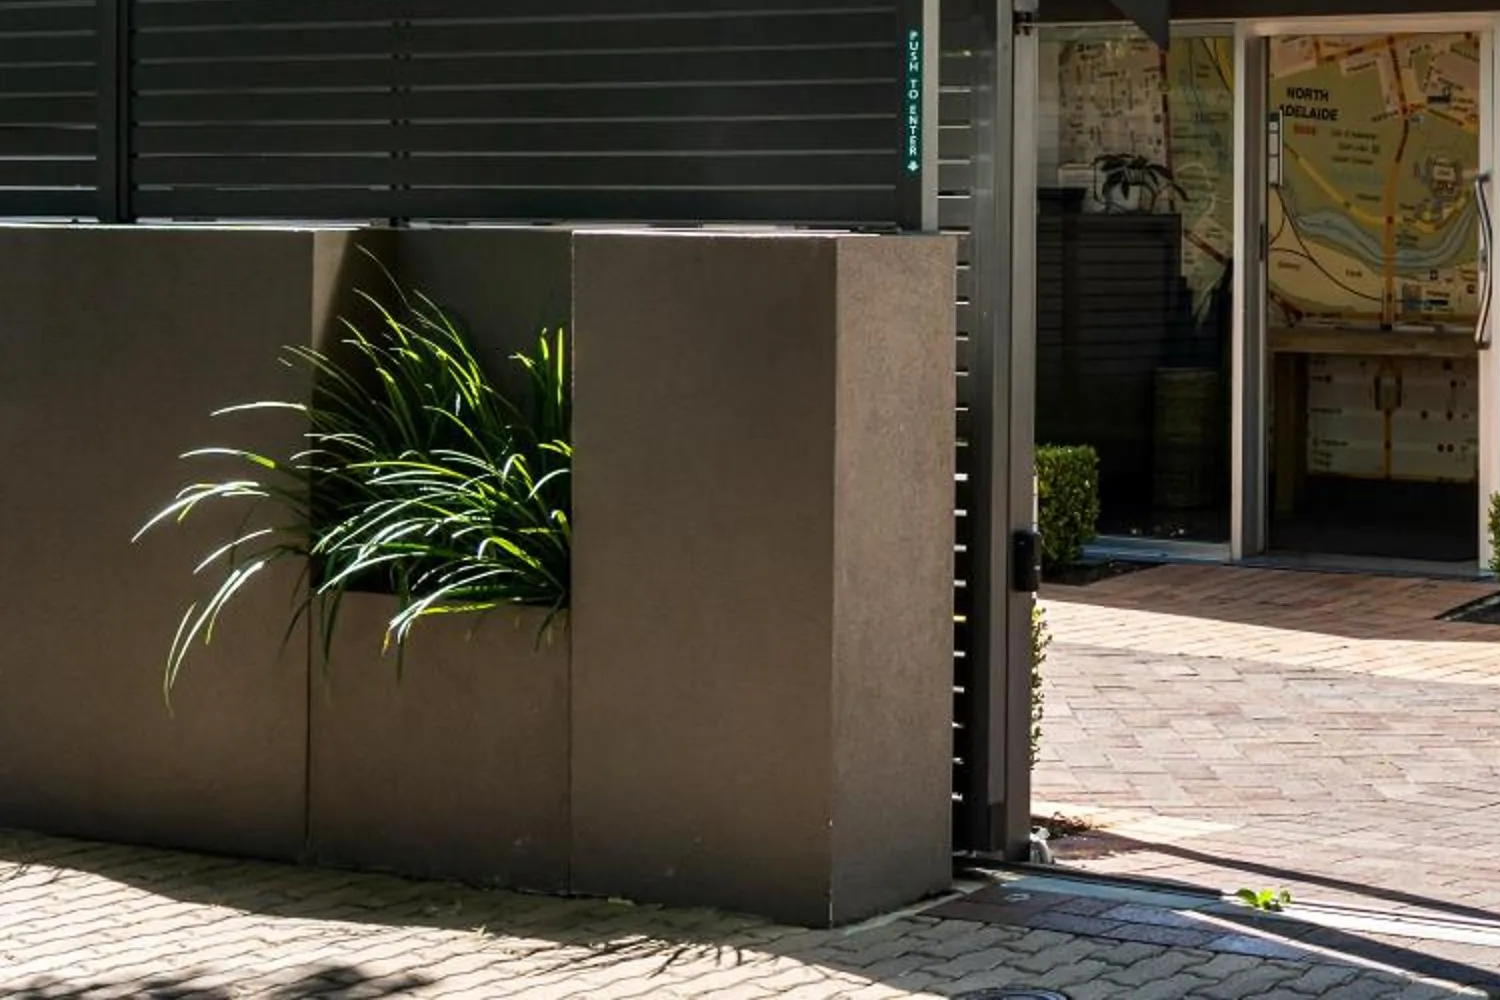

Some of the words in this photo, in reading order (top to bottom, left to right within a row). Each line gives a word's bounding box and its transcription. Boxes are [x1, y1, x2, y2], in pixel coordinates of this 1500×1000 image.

[908, 30, 919, 72] PUSH
[908, 79, 919, 99] TO
[1287, 86, 1329, 103] NORTH
[908, 105, 919, 156] ENTER
